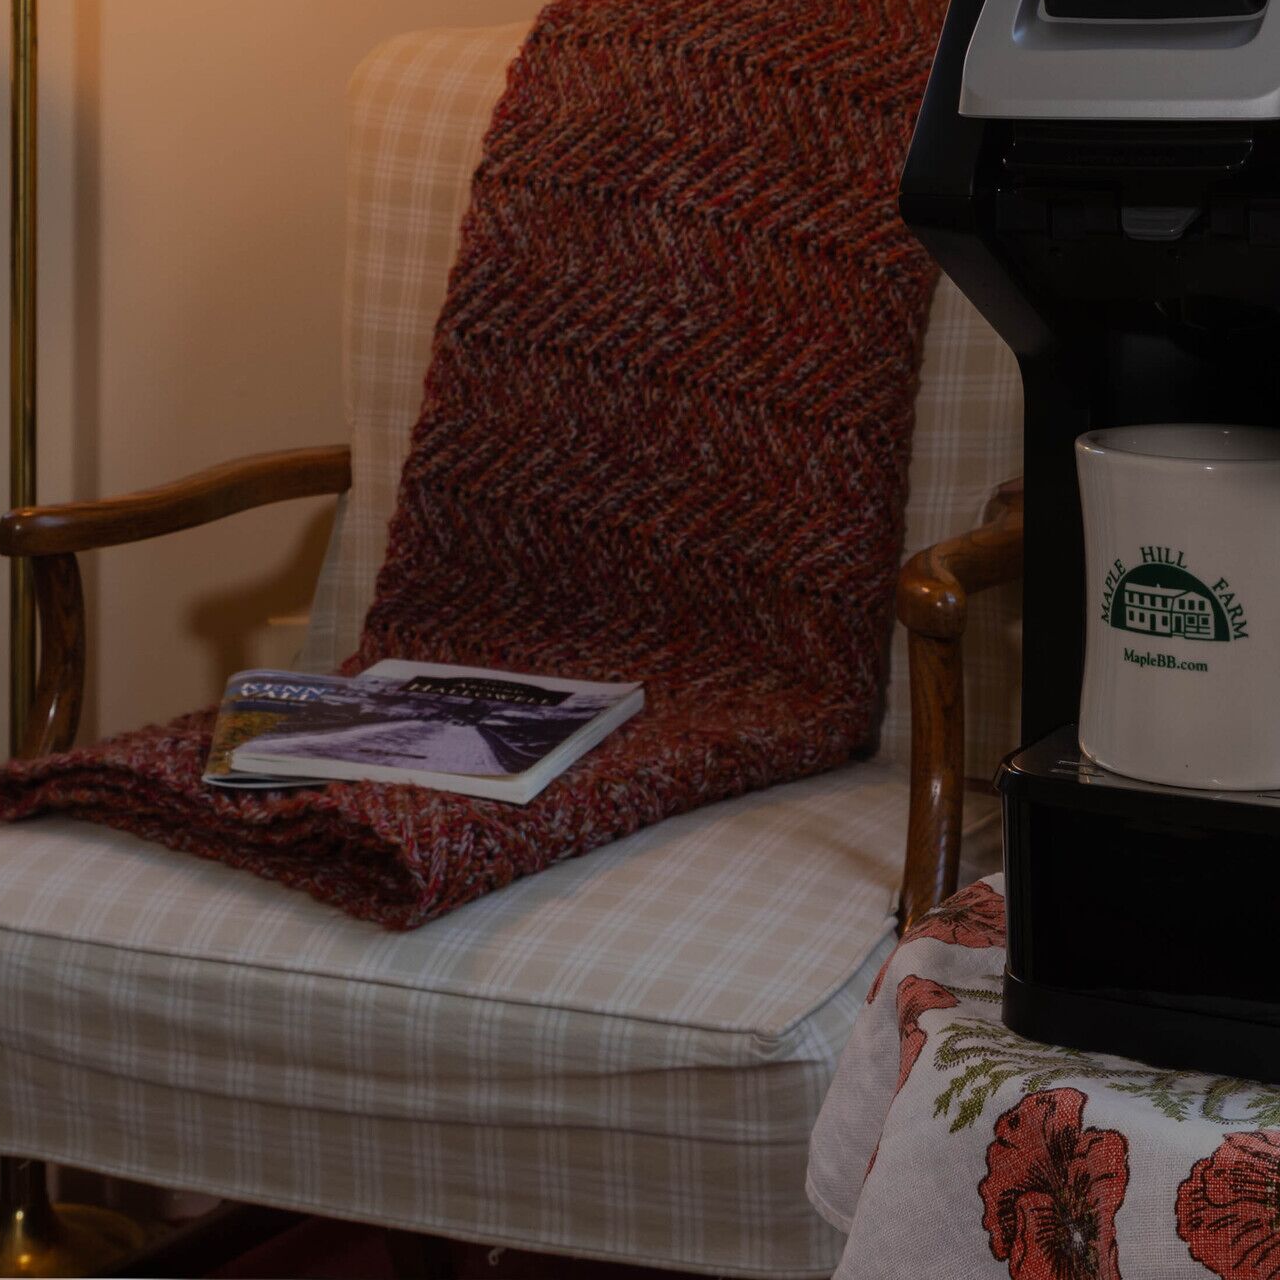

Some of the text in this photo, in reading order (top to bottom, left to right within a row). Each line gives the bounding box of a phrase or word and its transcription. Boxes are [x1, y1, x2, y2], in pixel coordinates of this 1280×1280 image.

[1101, 545, 1249, 641] MAPLE HILL FARM
[1123, 647, 1209, 673] MapleBB.com
